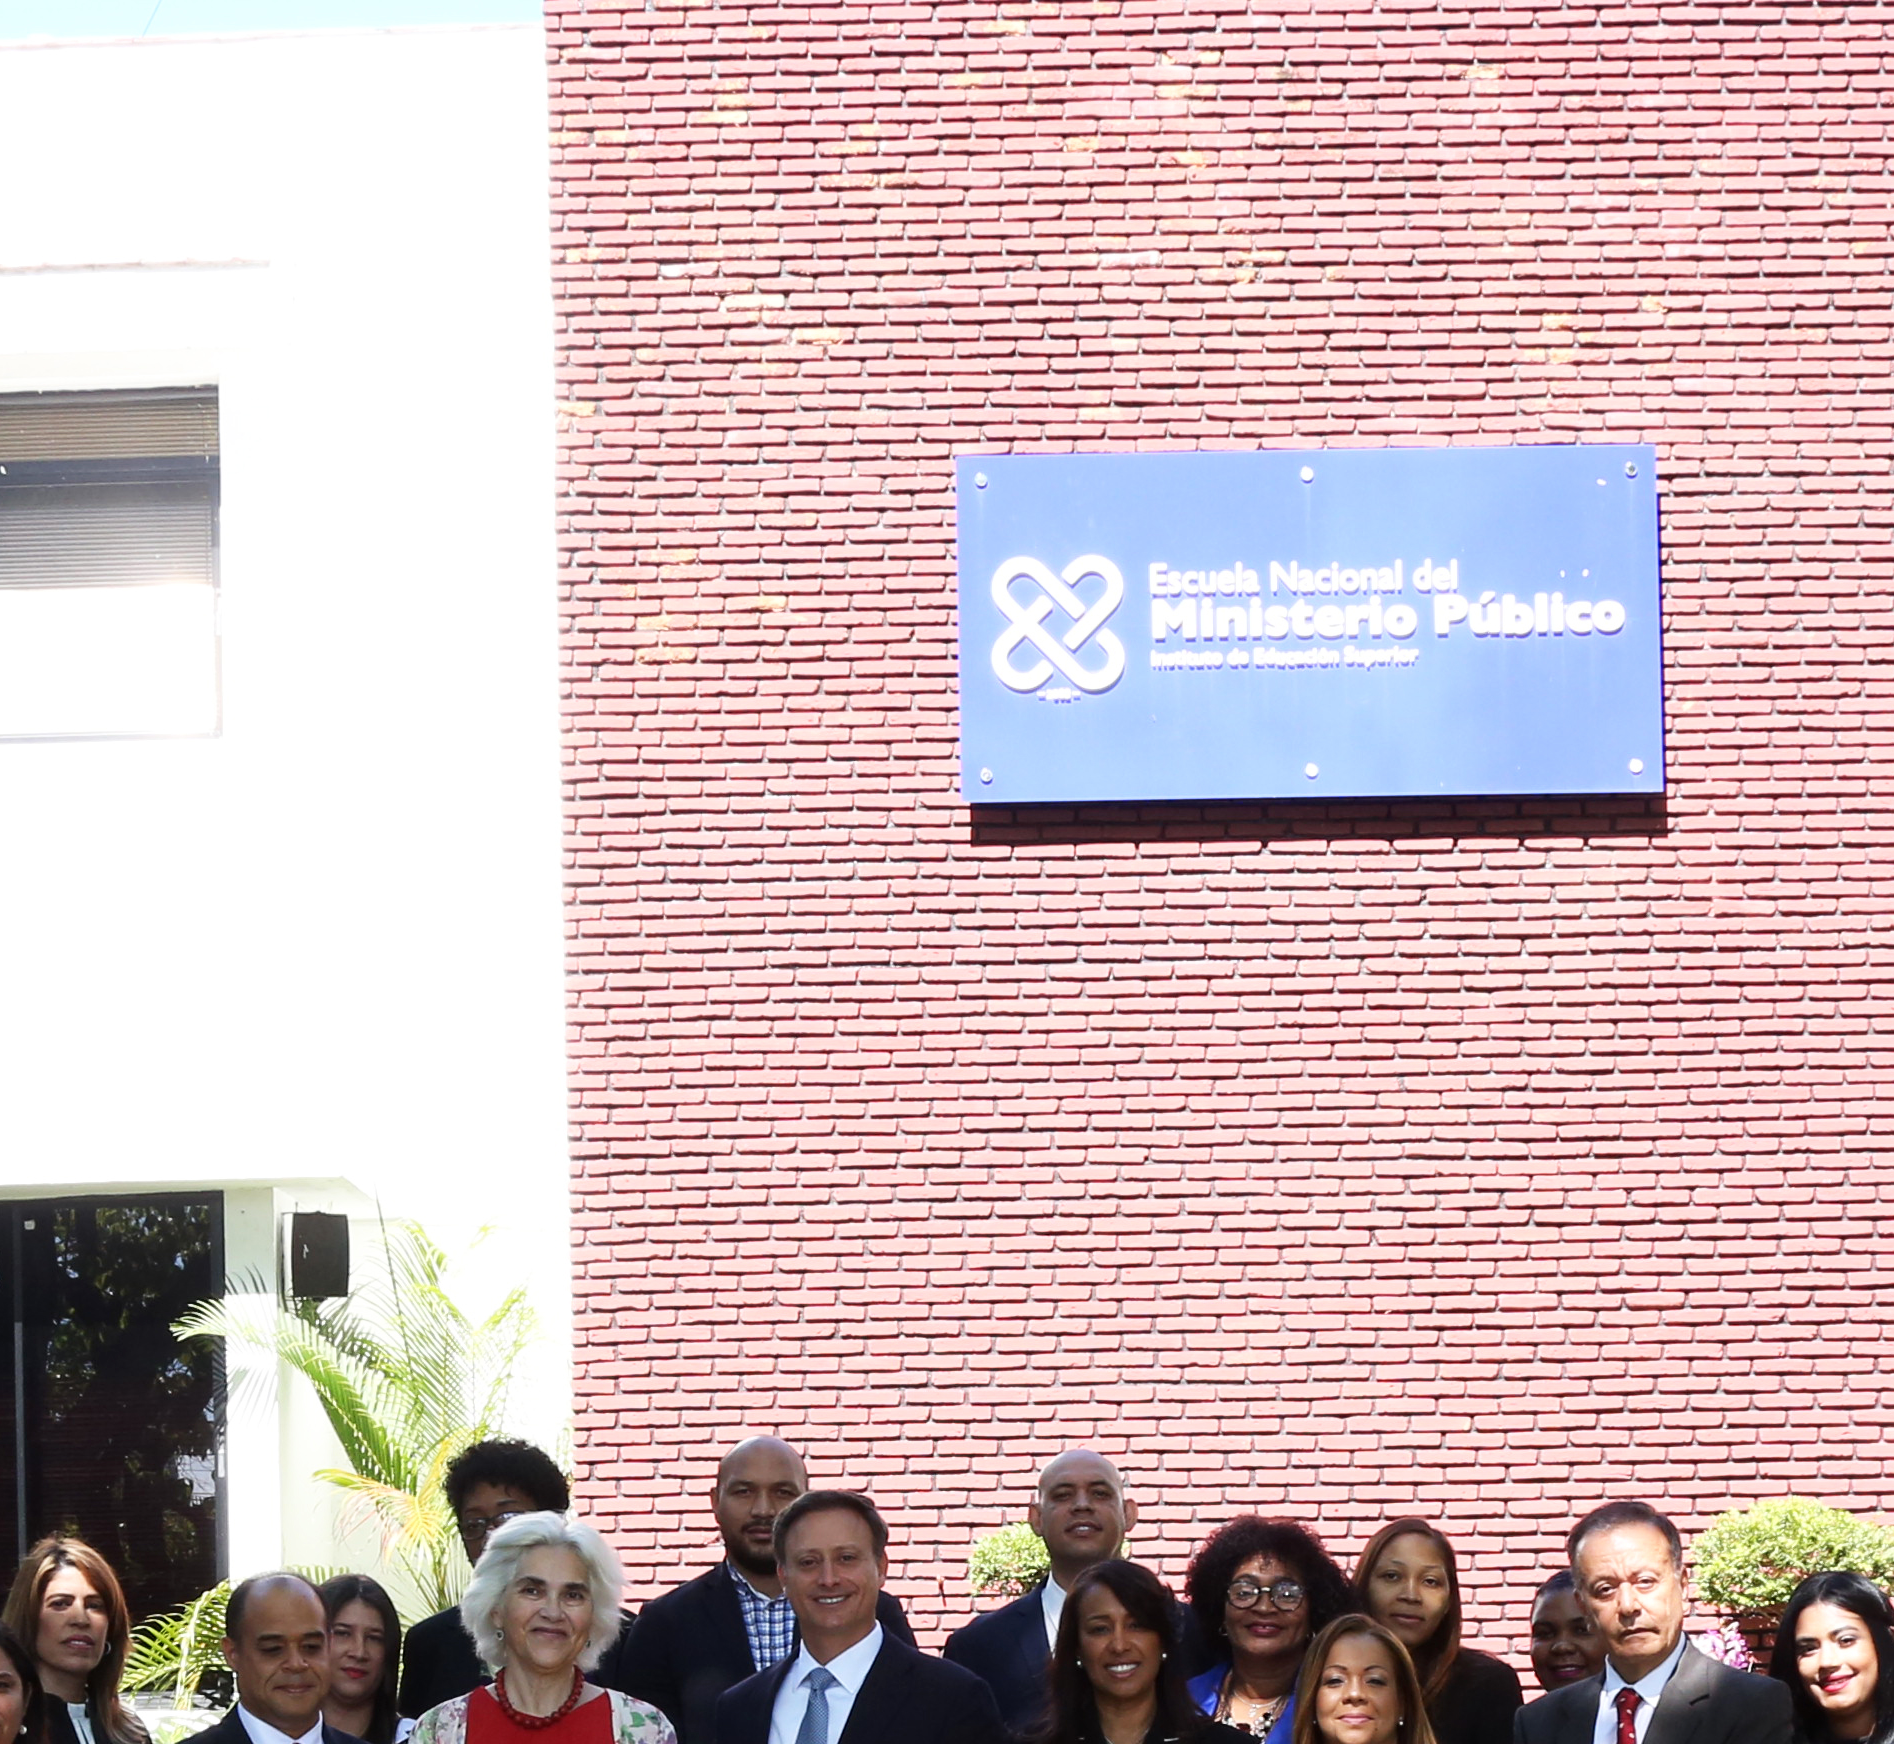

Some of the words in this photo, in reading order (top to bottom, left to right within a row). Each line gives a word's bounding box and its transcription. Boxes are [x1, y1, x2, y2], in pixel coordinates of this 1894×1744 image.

[1148, 561, 1261, 597] Escuela
[1269, 558, 1404, 595] Nacional
[1412, 557, 1458, 594] del
[1151, 595, 1418, 642] Ministerio
[1433, 590, 1626, 638] Público
